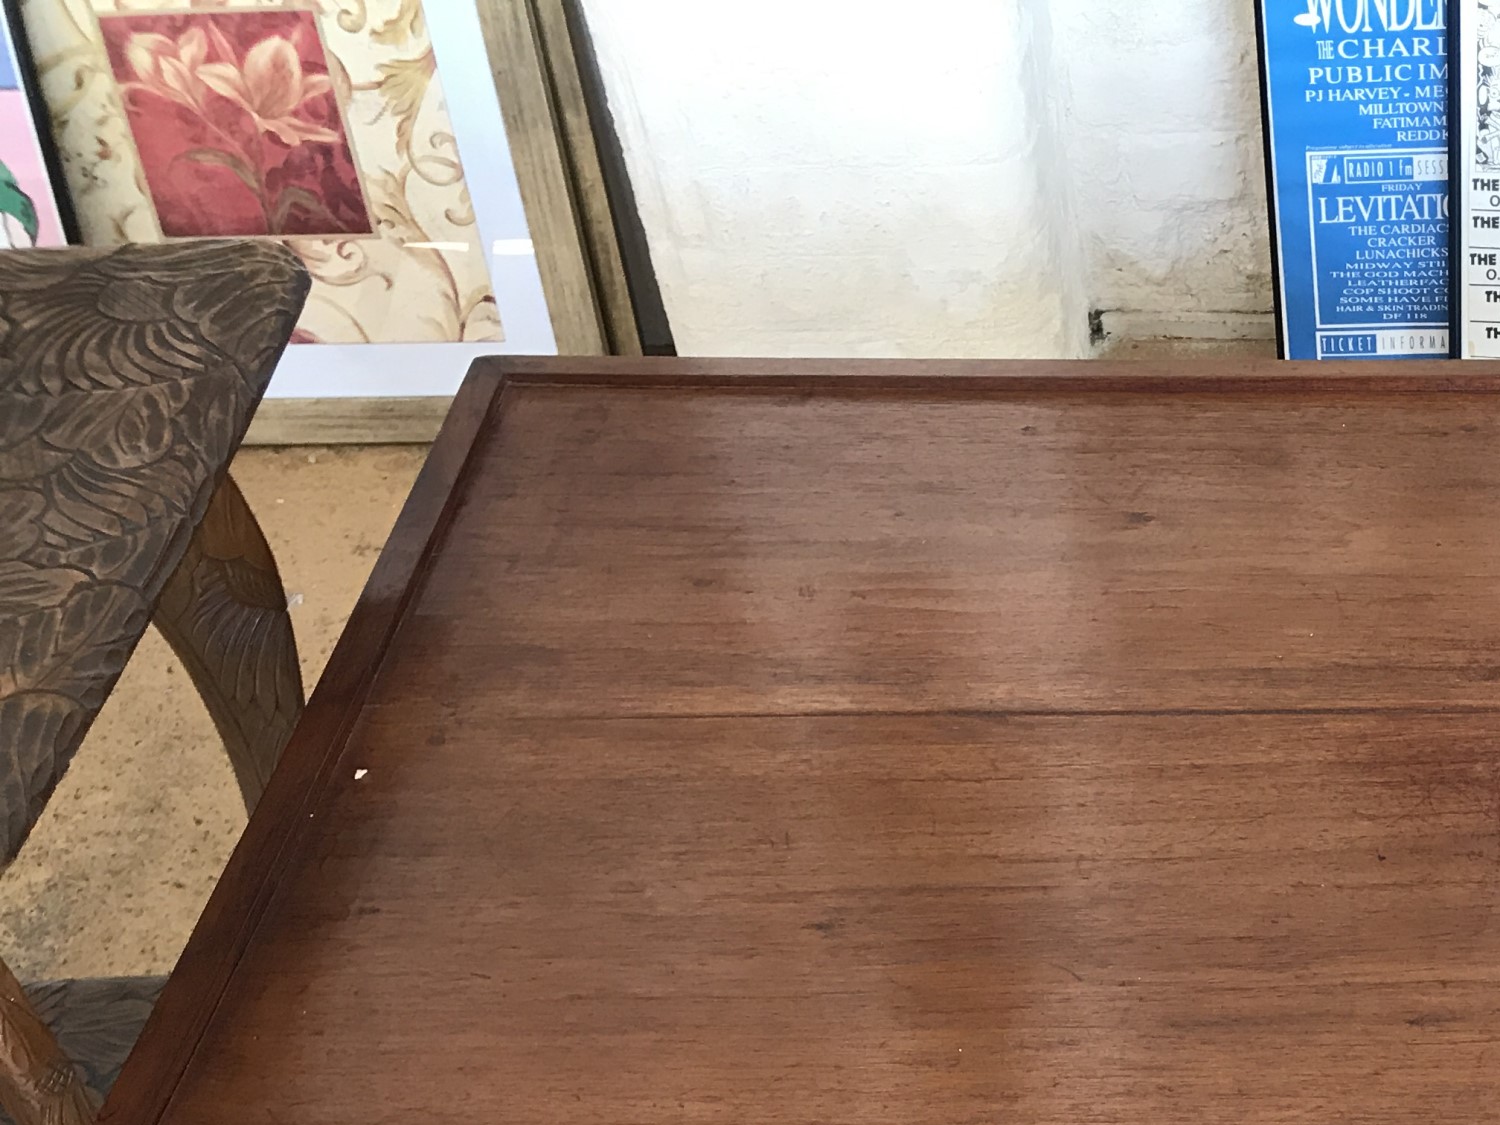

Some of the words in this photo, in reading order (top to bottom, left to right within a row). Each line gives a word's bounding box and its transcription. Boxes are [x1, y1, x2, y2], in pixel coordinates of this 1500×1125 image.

[1316, 40, 1335, 60] THE
[1308, 64, 1413, 85] PUBLIC
[1418, 63, 1448, 81] IM
[1305, 89, 1323, 103] PJ
[1328, 87, 1402, 102] HARVEY
[1415, 85, 1448, 99] ME
[1373, 116, 1431, 129] FATIMA
[1397, 130, 1441, 142] REDD
[1349, 160, 1384, 178] RADIO
[1388, 160, 1394, 177] 1
[1417, 159, 1448, 176] SESS
[1381, 183, 1423, 193] FRIDAY
[1472, 178, 1500, 191] THE
[1318, 193, 1448, 224] LEVITATI
[1472, 216, 1500, 229] THE
[1348, 225, 1377, 236] THE
[1367, 236, 1436, 247] CRACKER
[1356, 247, 1448, 260] LUNACHICKS
[1469, 253, 1497, 266] THE
[1346, 262, 1414, 270] MIDWAY
[1330, 271, 1361, 279] THE
[1364, 270, 1399, 278] GOD
[1486, 268, 1500, 281] O.
[1342, 287, 1374, 295] COP
[1378, 287, 1430, 295] SHOOT
[1339, 296, 1384, 304] SOME
[1321, 337, 1372, 352] TICKET
